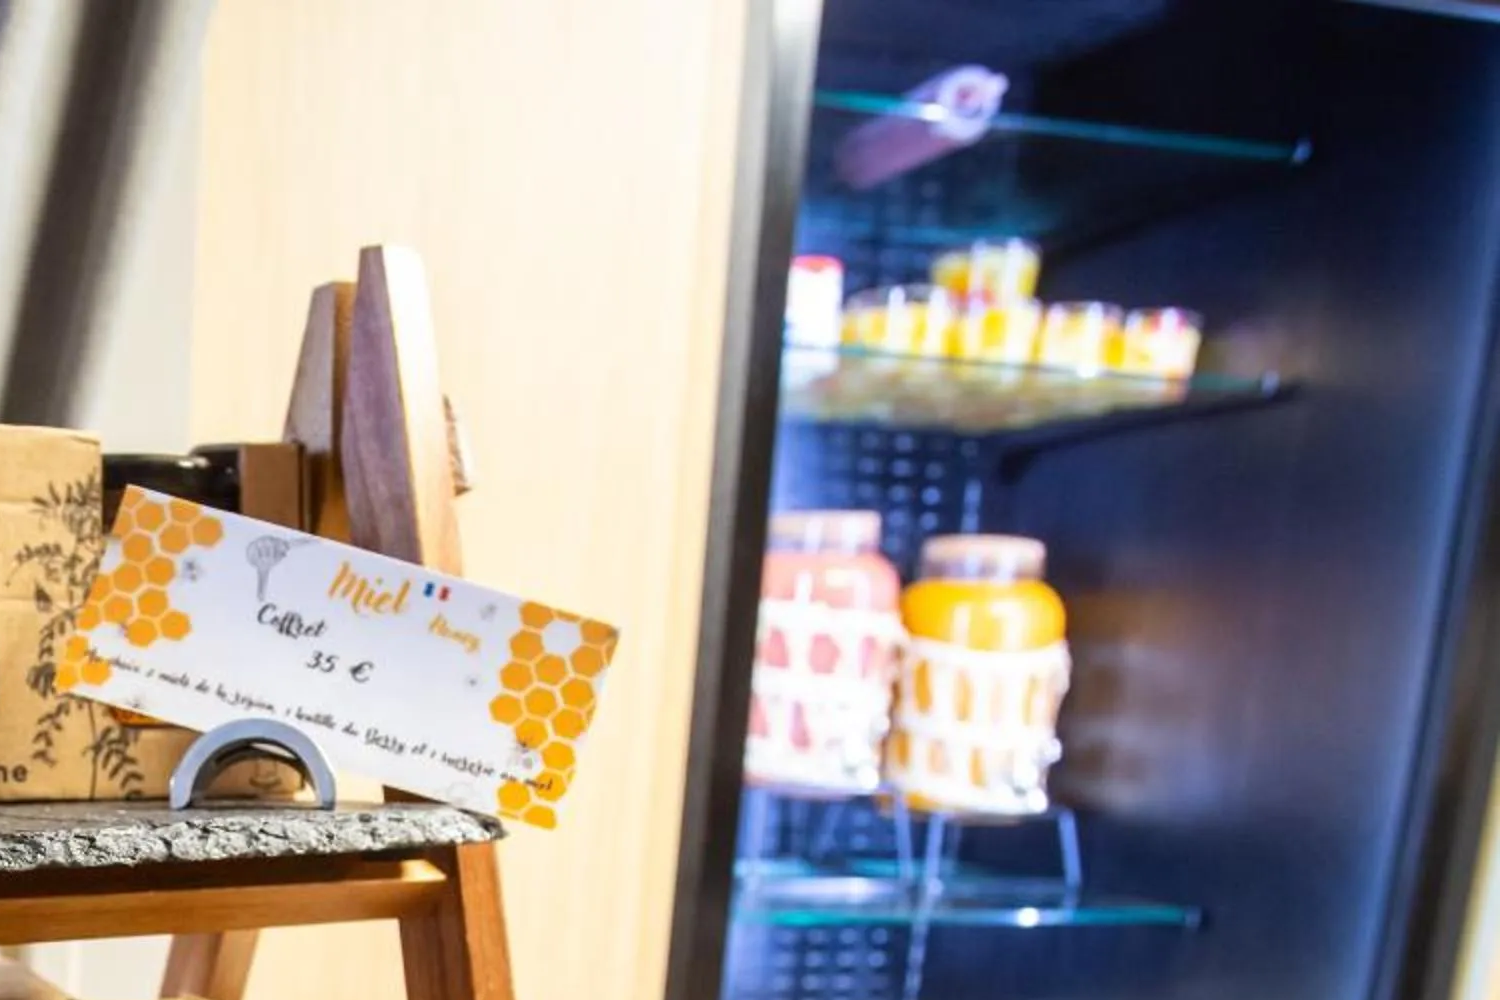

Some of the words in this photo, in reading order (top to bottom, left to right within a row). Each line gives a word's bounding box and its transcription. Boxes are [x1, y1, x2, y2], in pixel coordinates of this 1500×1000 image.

[327, 560, 413, 614] Miel
[257, 603, 325, 639] Coffret
[306, 650, 339, 673] 35
[350, 661, 375, 683] €
